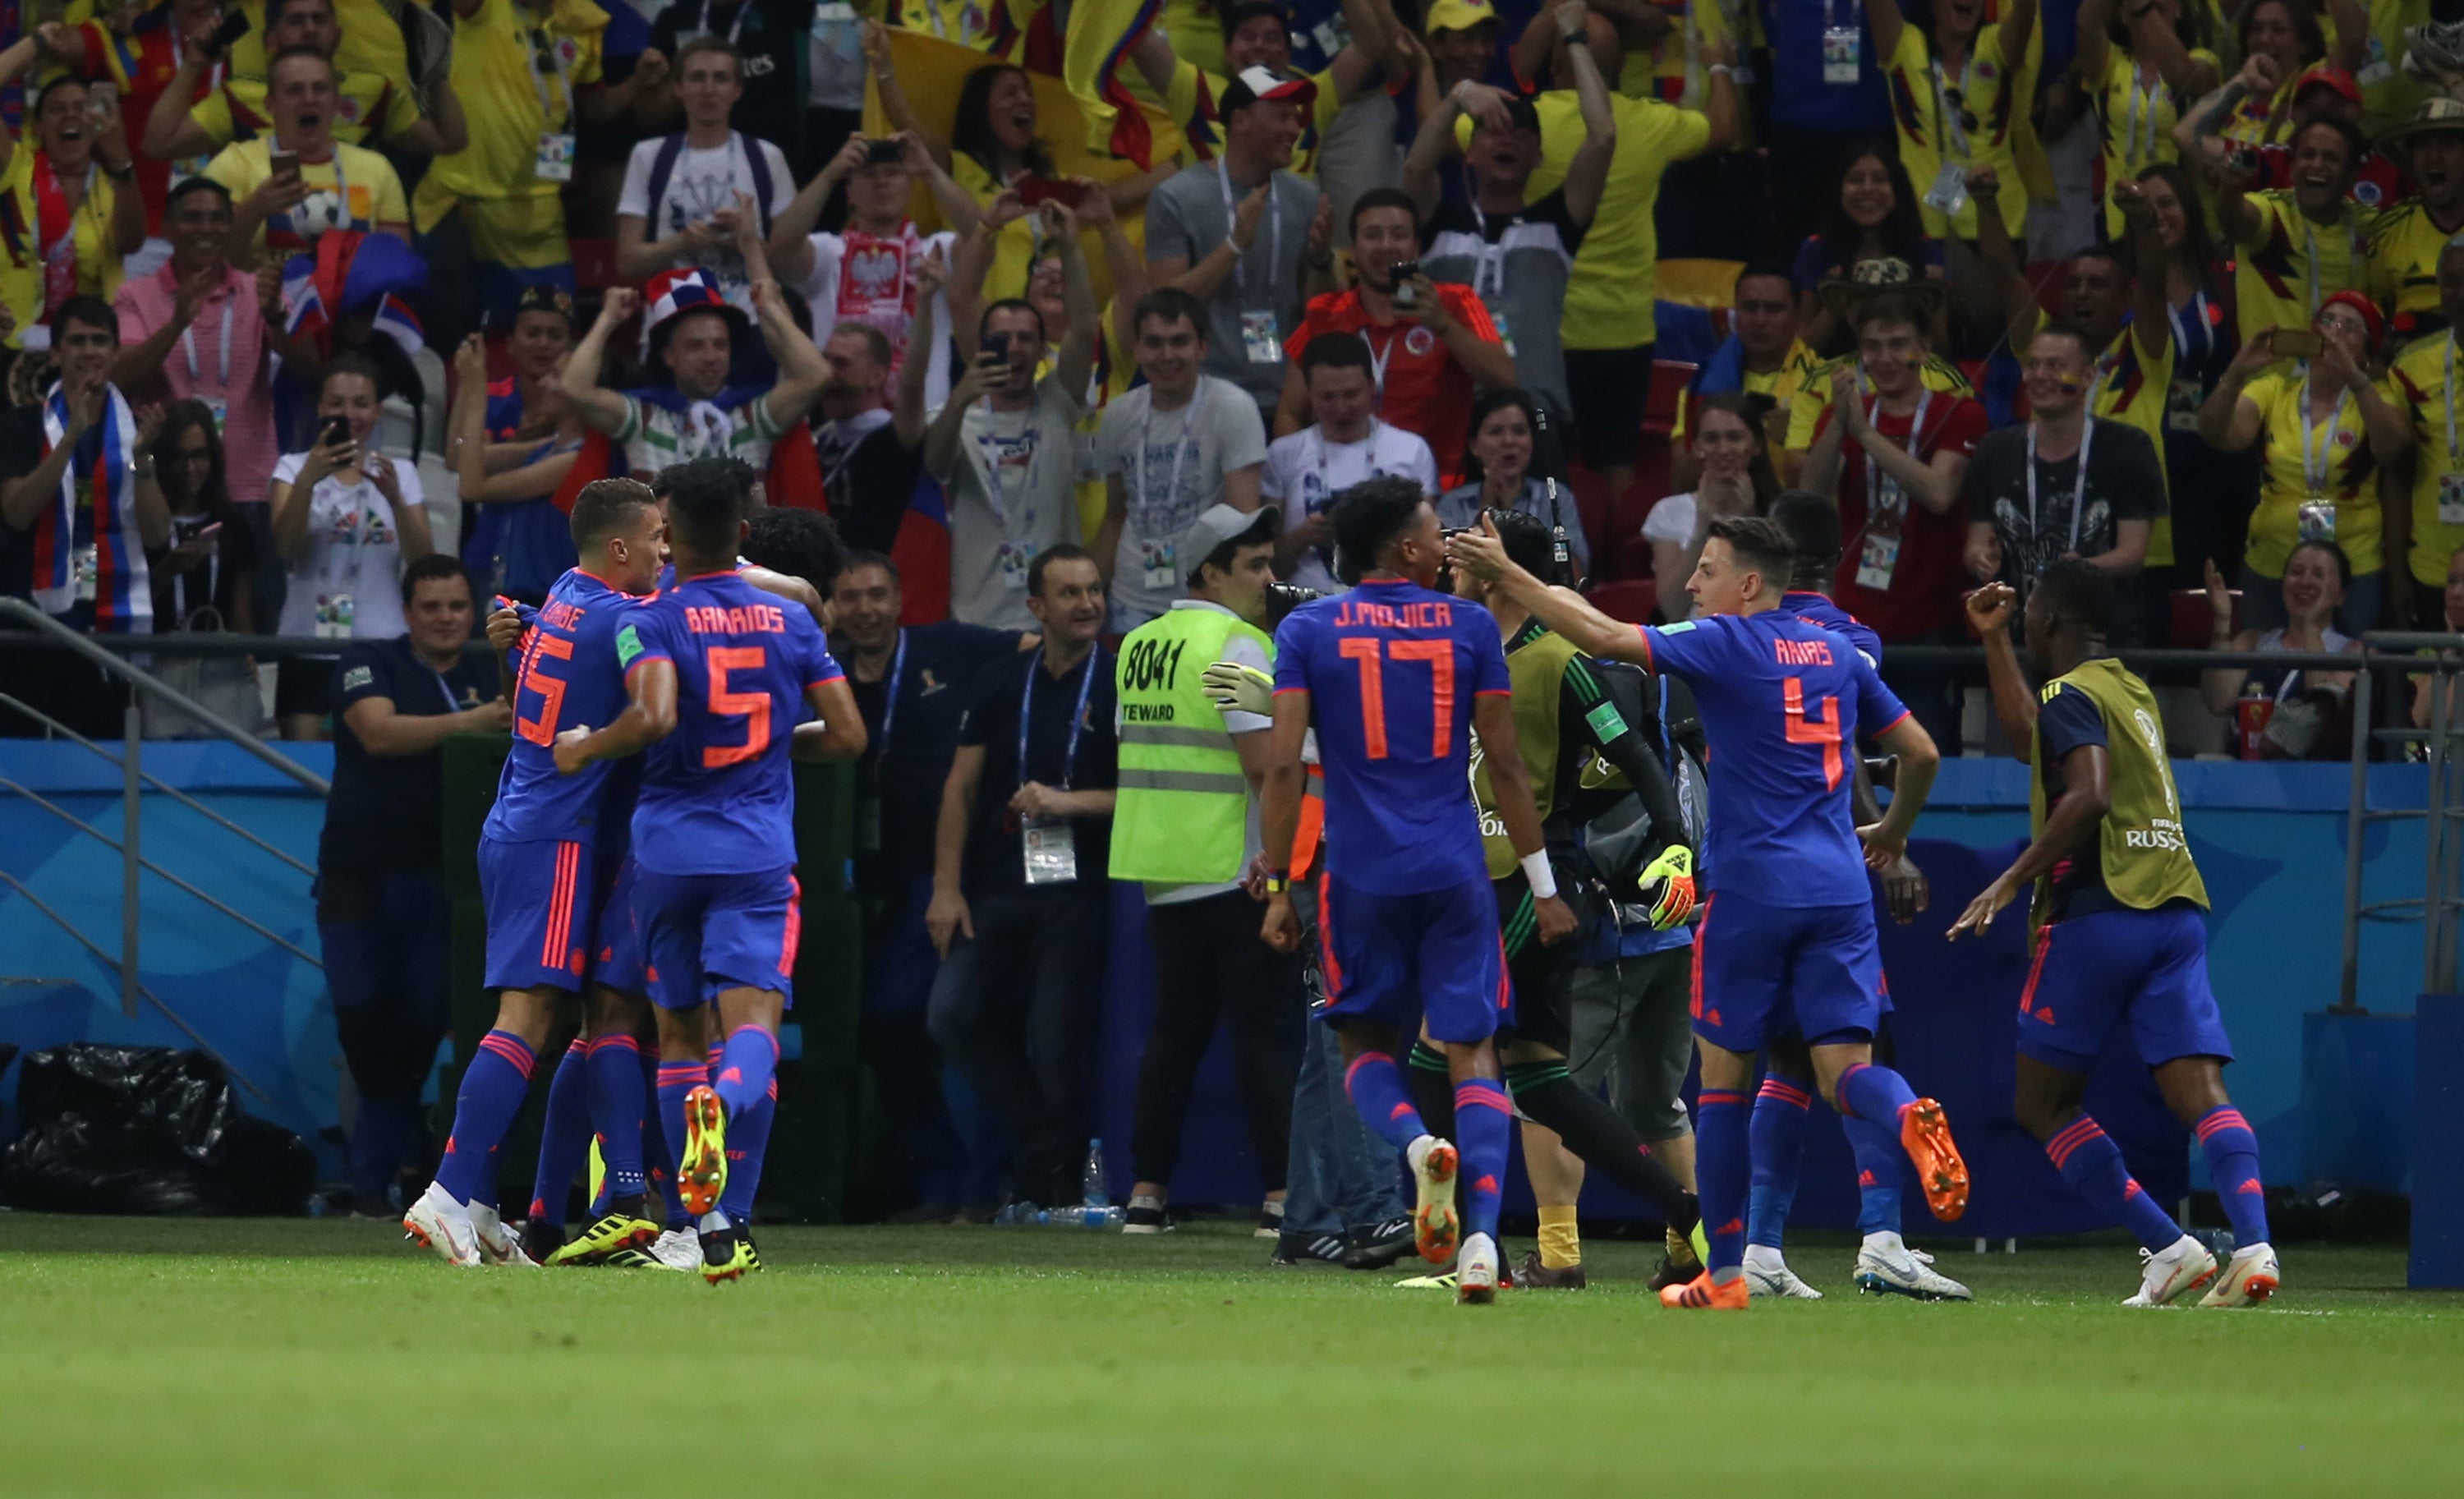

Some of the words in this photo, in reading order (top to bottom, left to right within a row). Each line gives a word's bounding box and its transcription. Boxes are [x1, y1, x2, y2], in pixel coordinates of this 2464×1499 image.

[685, 604, 785, 635] BARRIOS
[1335, 602, 1453, 628] J.MOJICA
[1124, 638, 1186, 691] 8041
[1774, 638, 1833, 666] ARIAS
[702, 646, 770, 768] 5
[1123, 703, 1175, 720] TEWARD
[1339, 637, 1455, 760] 17
[1783, 677, 1844, 793] 4
[2126, 830, 2185, 852] RUSS
